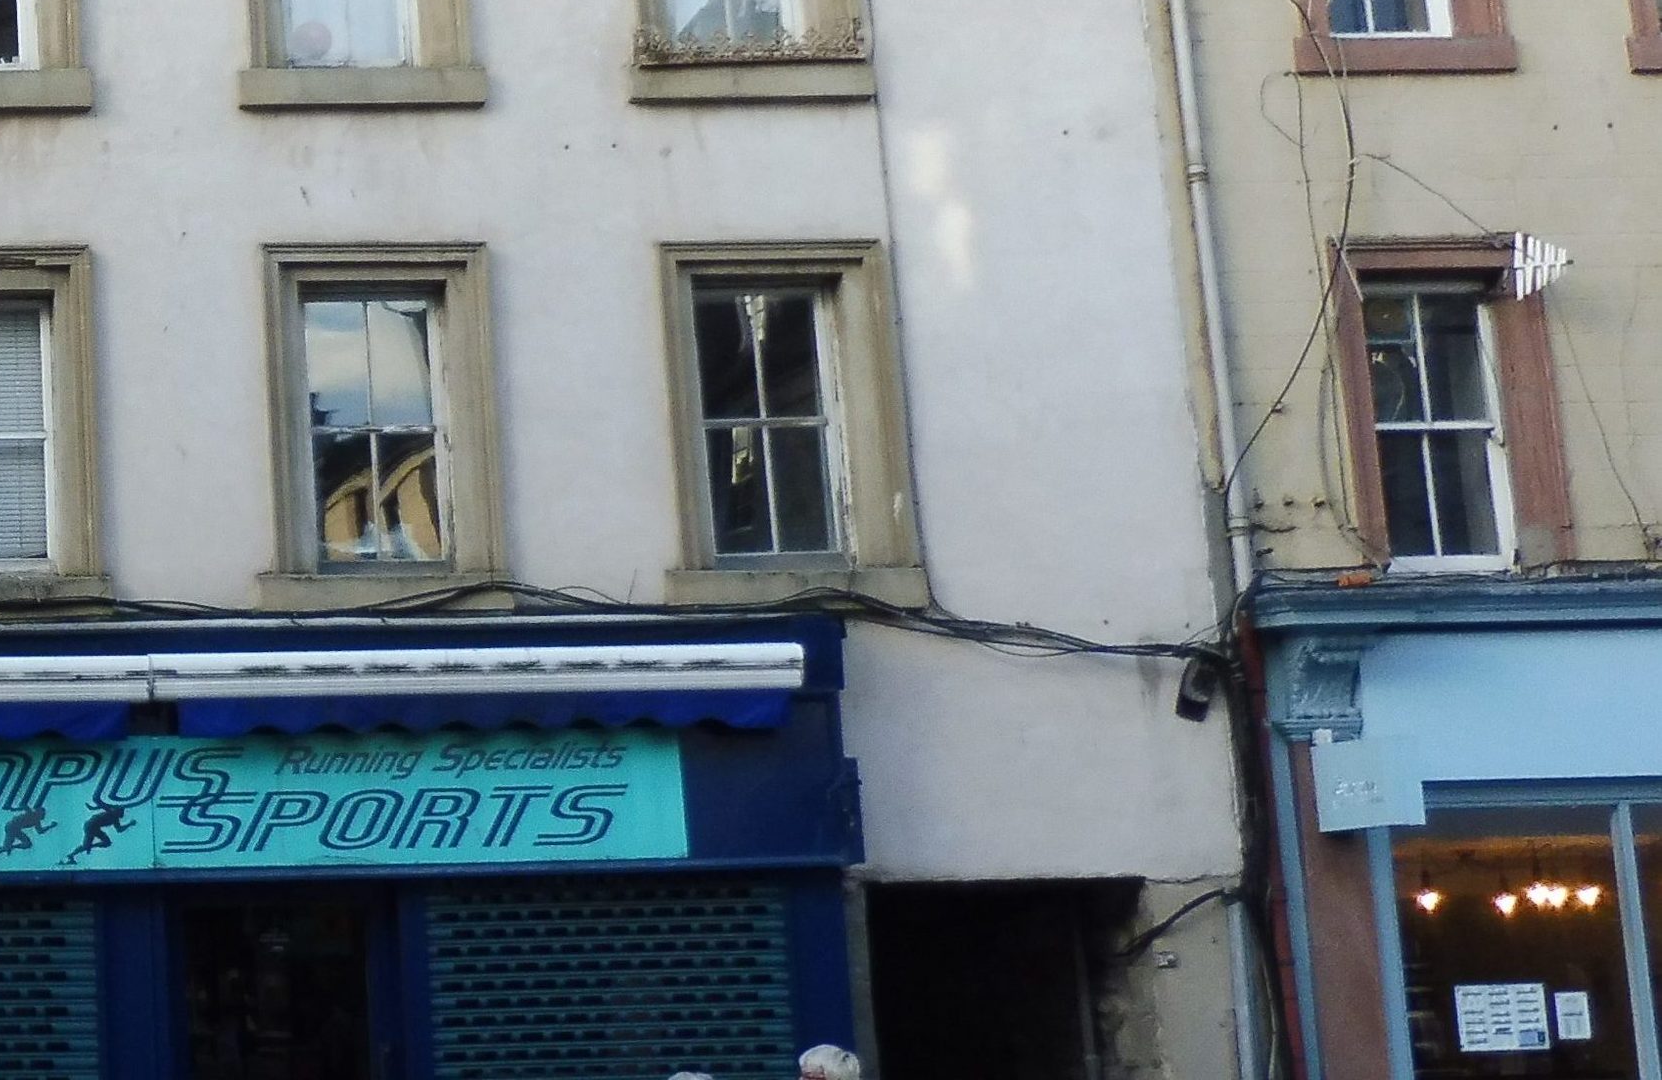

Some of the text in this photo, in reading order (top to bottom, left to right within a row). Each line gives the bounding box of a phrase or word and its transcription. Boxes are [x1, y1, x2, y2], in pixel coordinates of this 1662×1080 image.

[274, 742, 627, 780] Running Specialists
[158, 784, 628, 853] SPORTS
